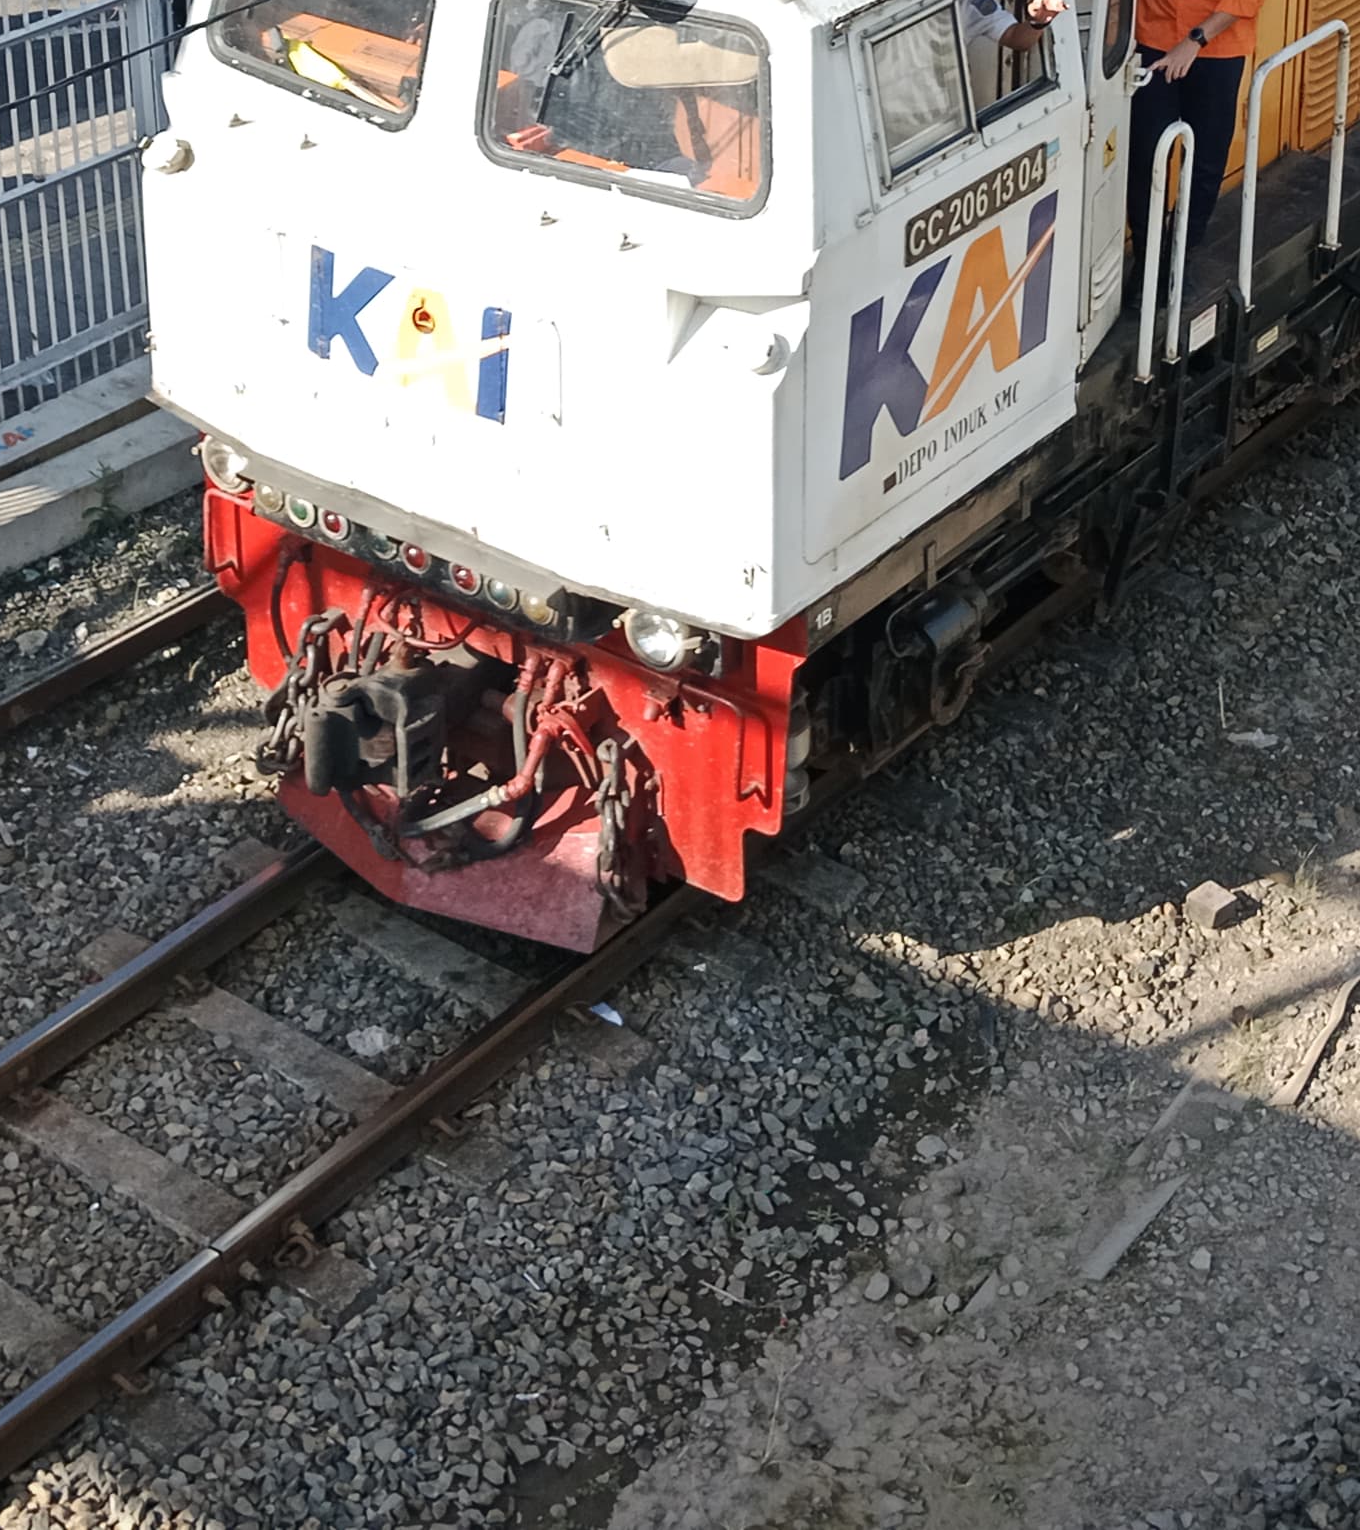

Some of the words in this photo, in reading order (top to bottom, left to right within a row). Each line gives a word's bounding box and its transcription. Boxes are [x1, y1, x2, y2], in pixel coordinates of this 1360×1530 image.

[909, 209, 944, 256] CC
[948, 181, 989, 236] 206
[992, 167, 1015, 208] 13
[1018, 148, 1044, 192] 04
[839, 189, 1059, 481] KAI
[898, 439, 937, 485] DEPO
[943, 402, 988, 453] INDUK
[815, 607, 833, 630] 1B
